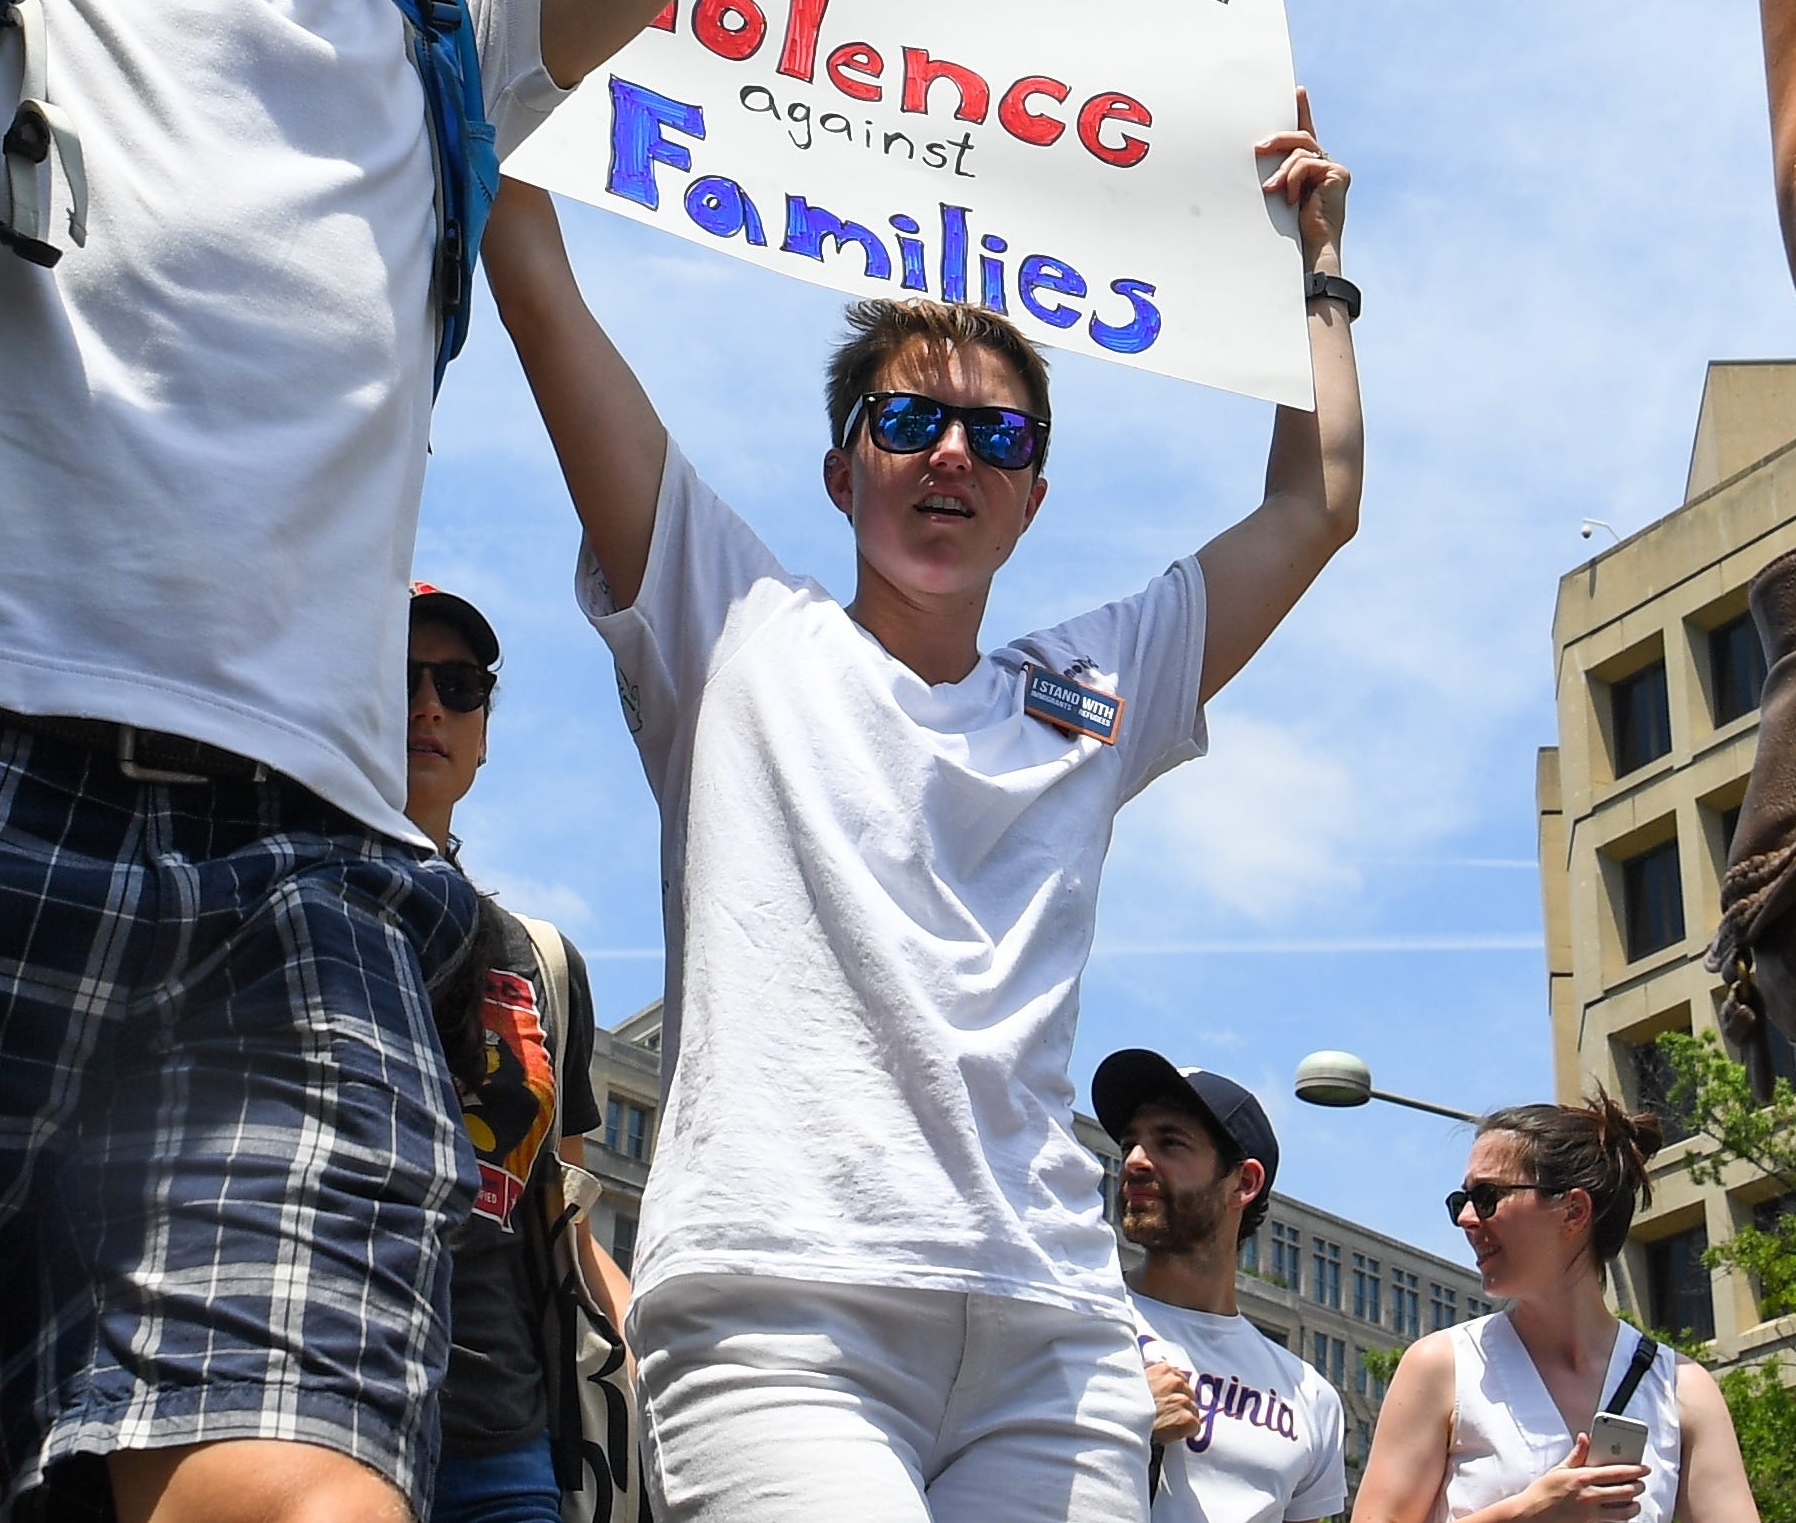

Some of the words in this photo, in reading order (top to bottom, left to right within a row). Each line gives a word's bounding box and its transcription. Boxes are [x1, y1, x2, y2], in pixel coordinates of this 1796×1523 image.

[739, 84, 978, 180] against
[604, 74, 1163, 356] Families
[1039, 680, 1081, 705] STAND
[1082, 696, 1115, 720] WITH
